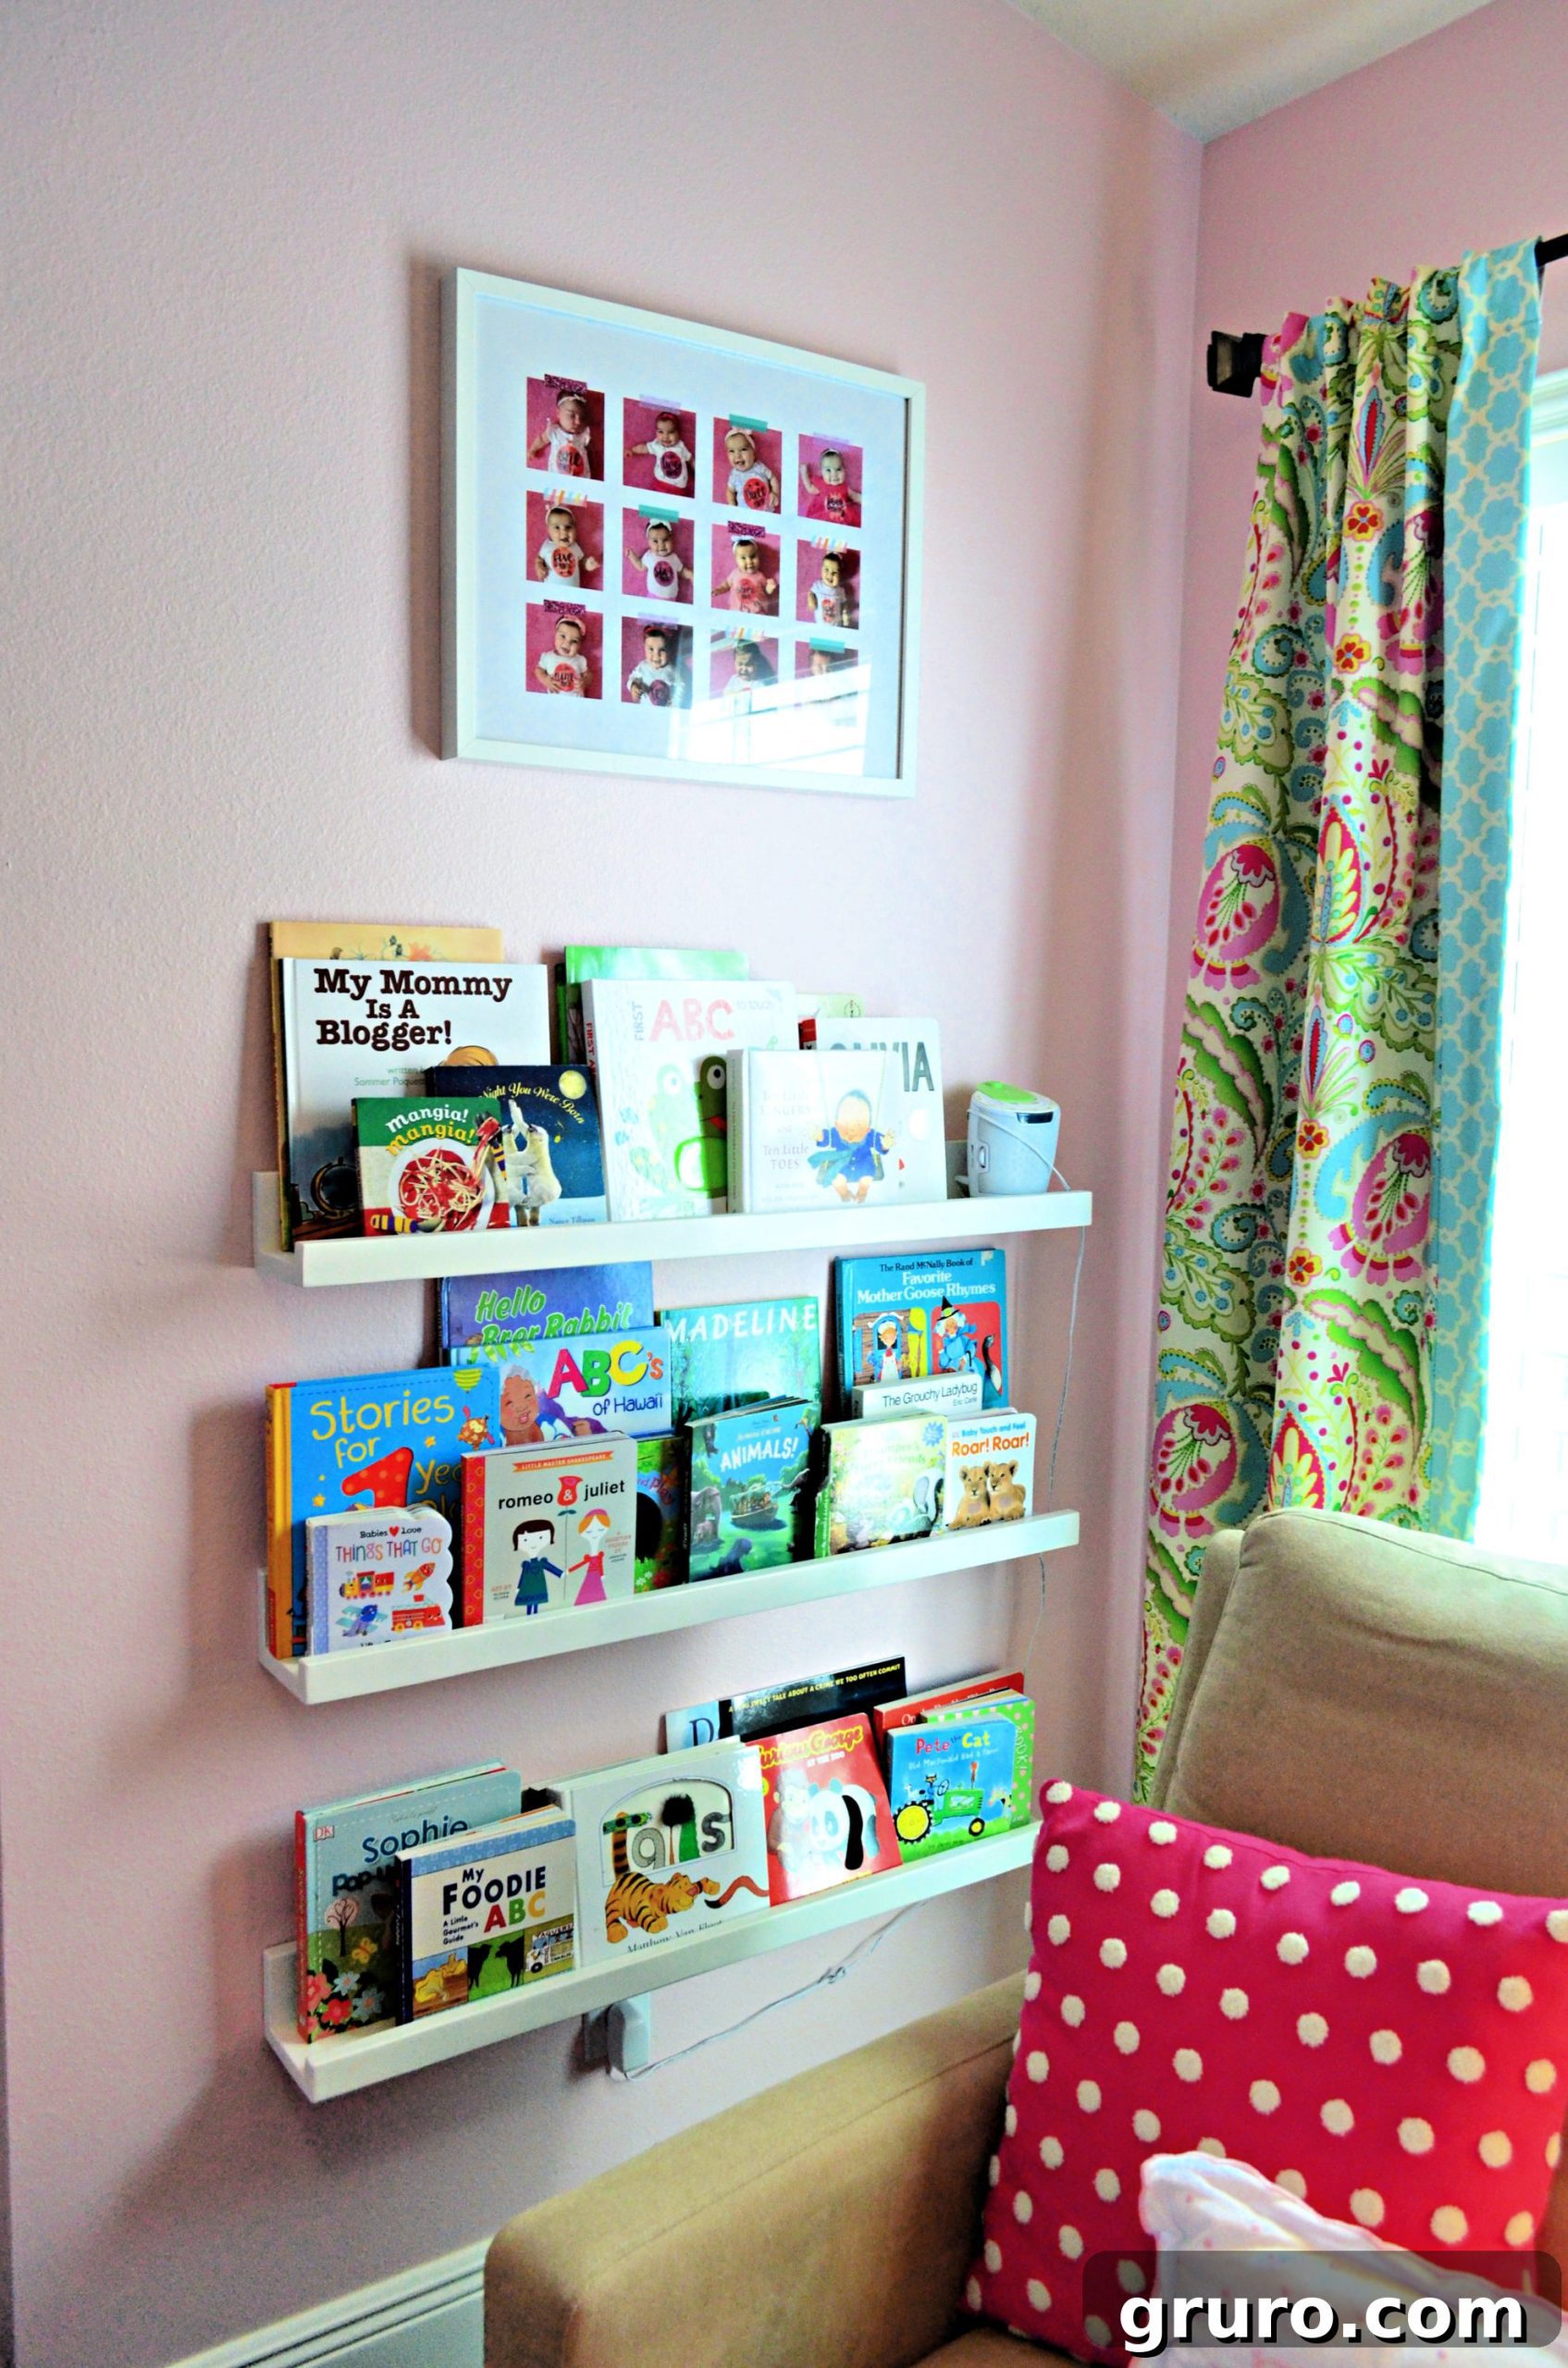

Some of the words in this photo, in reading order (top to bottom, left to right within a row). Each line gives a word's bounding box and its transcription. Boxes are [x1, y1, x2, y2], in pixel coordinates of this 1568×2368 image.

[314, 968, 372, 1001] My
[379, 969, 512, 1002] Mommy
[365, 999, 391, 1019] Is
[399, 999, 420, 1019] A
[649, 998, 735, 1042] ABC
[316, 1020, 452, 1052] Blogger!
[508, 1082, 532, 1098] You
[533, 1087, 561, 1104] Were
[559, 1099, 585, 1125] Born
[762, 1144, 782, 1155] Ten
[770, 1158, 800, 1170] TOES
[880, 1264, 895, 1273] The
[895, 1262, 915, 1272] Rand
[946, 1259, 965, 1268] Book
[965, 1258, 974, 1266] of
[902, 1270, 952, 1286] Favorite
[475, 1283, 547, 1324] Hello
[857, 1289, 902, 1304] Mother
[904, 1286, 945, 1300] Goose
[945, 1282, 996, 1299] Rhymes
[543, 1301, 633, 1339] Rabbit
[664, 1303, 817, 1343] MADELINE
[592, 1398, 611, 1416] of
[882, 1394, 902, 1408] The
[903, 1388, 940, 1406] Grouchy
[941, 1382, 978, 1399] Ladybug
[310, 1389, 455, 1441] Stories
[335, 1437, 381, 1469] for
[720, 1437, 799, 1473] ANIMALS!
[952, 1437, 989, 1457] Roar!
[993, 1432, 1030, 1451] Roar!
[498, 1493, 553, 1511] romeo
[584, 1479, 625, 1501] juliet
[360, 1529, 388, 1538] Babies
[401, 1526, 422, 1535] Love
[387, 1539, 418, 1559] THAT
[422, 1537, 442, 1555] GO
[788, 1685, 809, 1698] ABOUT
[809, 1684, 815, 1693] A
[846, 1674, 858, 1684] TOO
[858, 1669, 878, 1681] OFTEN
[878, 1663, 901, 1675] COMMIT
[916, 1737, 951, 1755] Pete
[962, 1730, 992, 1748] Cat
[315, 1827, 334, 1840] DK
[363, 1815, 468, 1863] Sophie
[462, 1867, 485, 1883] My
[443, 1866, 546, 1916] FOODIE
[451, 1916, 468, 1925] Little
[484, 1890, 547, 1933] ABC
[443, 1921, 479, 1937] Gourmet's
[443, 1934, 464, 1945] Guide
